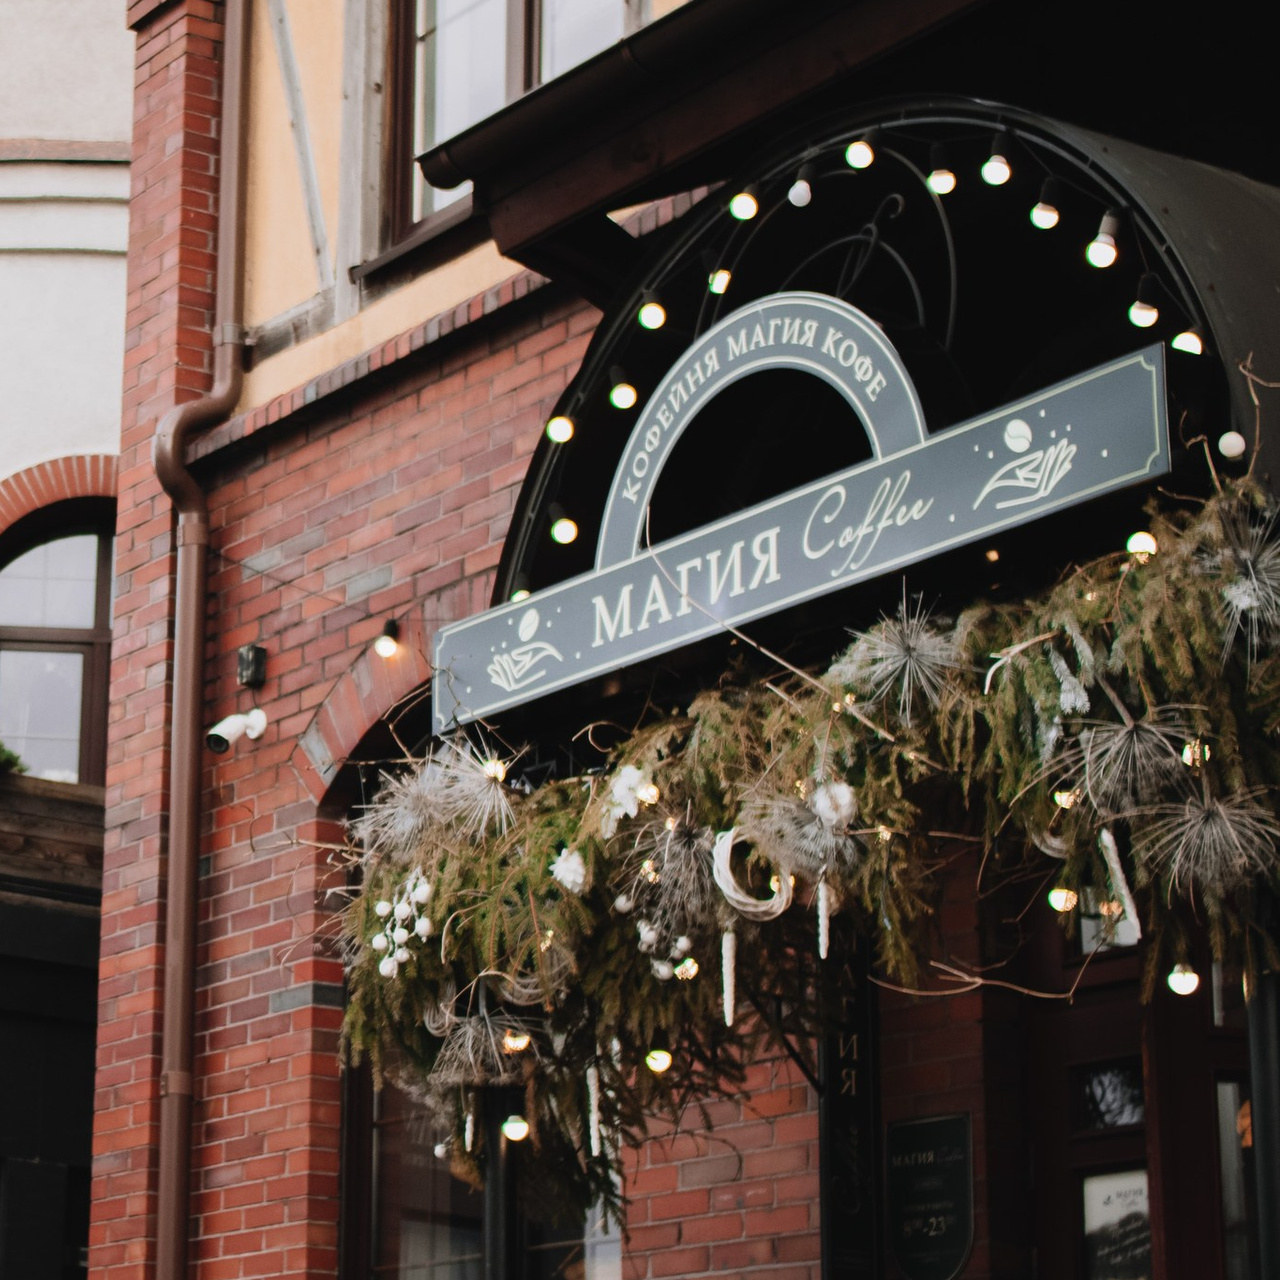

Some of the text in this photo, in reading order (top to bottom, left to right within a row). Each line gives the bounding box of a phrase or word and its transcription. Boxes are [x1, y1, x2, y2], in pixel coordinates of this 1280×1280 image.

[622, 317, 888, 504] КОФЕЙНЯ МАГИЯ КОФЕ
[591, 470, 934, 648] МАГИЯ Coffee
